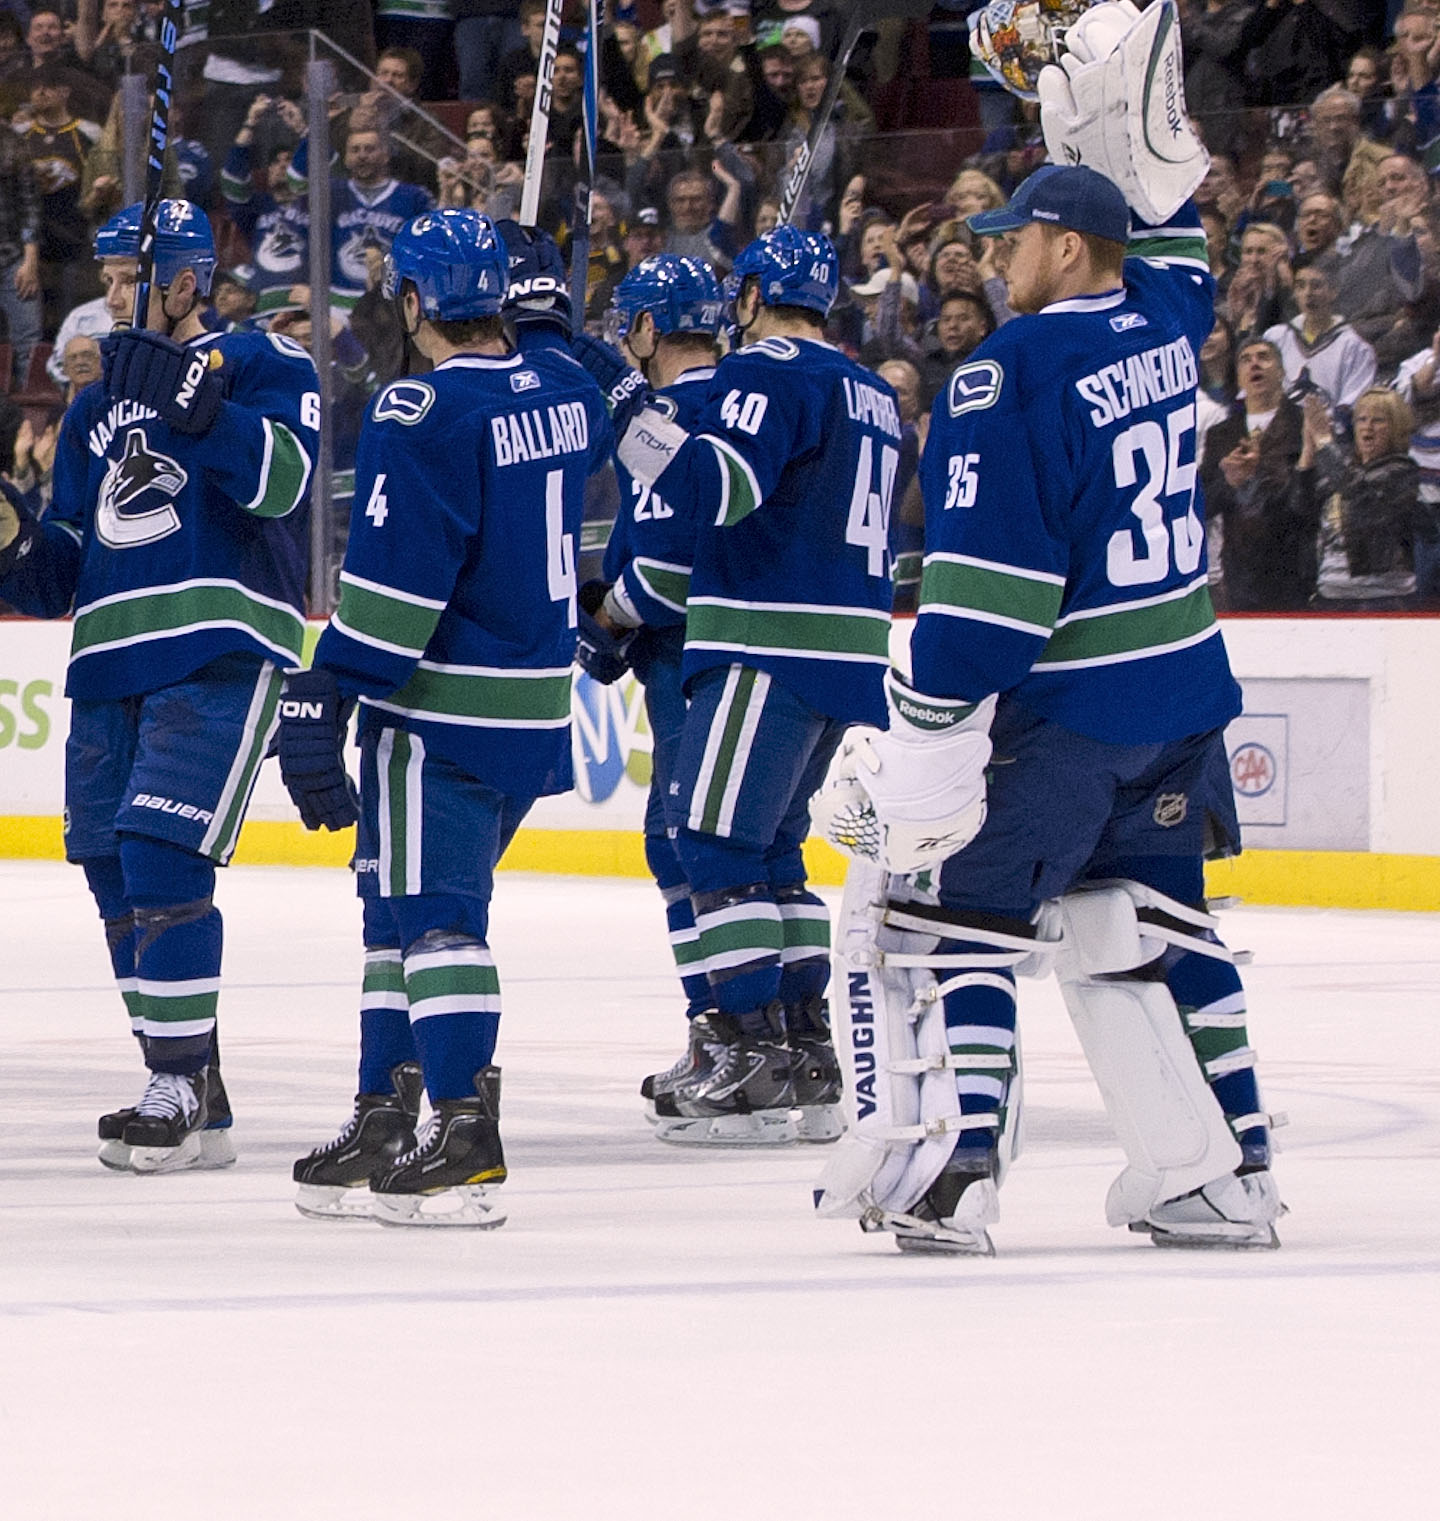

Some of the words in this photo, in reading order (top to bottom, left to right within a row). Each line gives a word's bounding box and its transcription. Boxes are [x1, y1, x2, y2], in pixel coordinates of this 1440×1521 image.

[477, 269, 489, 292] 4
[809, 262, 830, 284] 40
[300, 392, 321, 431] 6
[491, 401, 589, 468] BALLARD
[721, 388, 769, 436] 40
[365, 473, 389, 528] 4
[845, 435, 900, 578] 40
[944, 453, 981, 511] 35
[1107, 403, 1205, 588] 35
[545, 468, 579, 629] 4
[898, 698, 955, 725] Reebok
[846, 971, 877, 1121] VAUGHN
